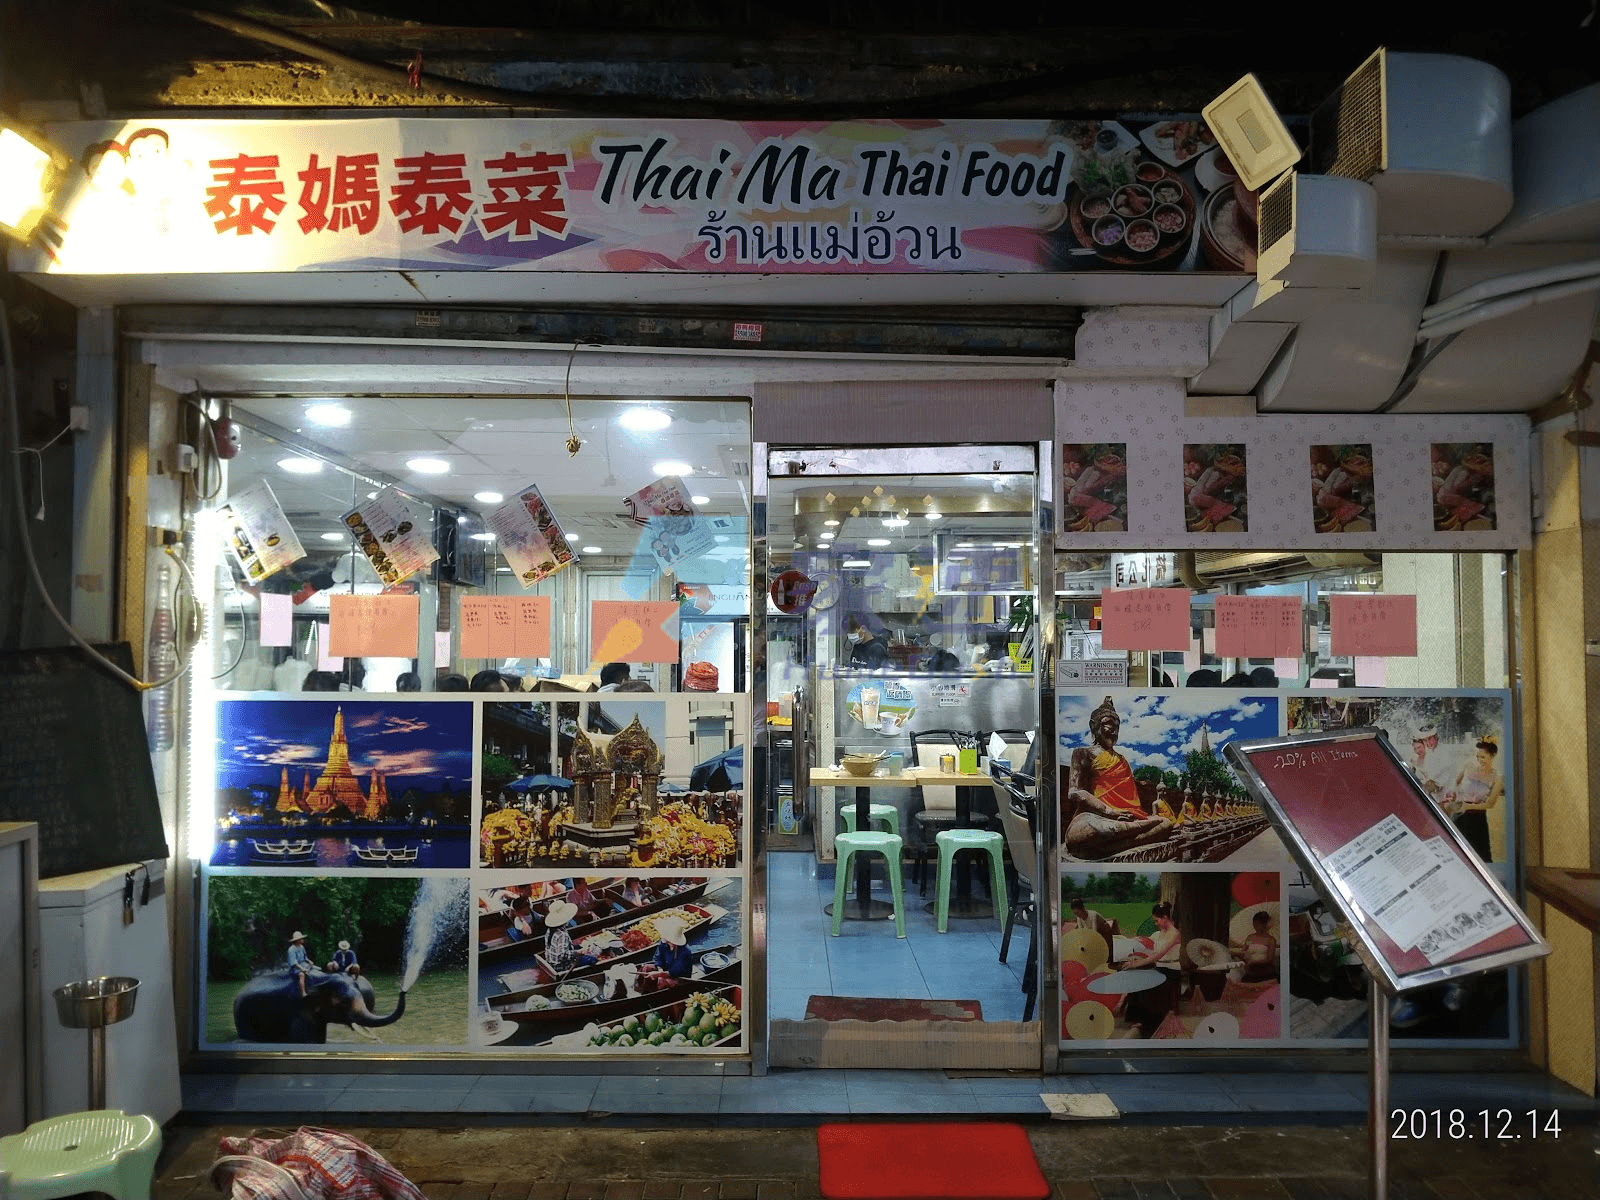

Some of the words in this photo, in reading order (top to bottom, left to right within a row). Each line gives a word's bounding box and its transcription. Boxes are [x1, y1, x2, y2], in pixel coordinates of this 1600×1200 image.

[205, 152, 570, 238] 泰媽泰菜
[599, 137, 732, 203] Thai
[739, 144, 842, 205] Ma
[860, 148, 949, 197] Thai
[960, 149, 1066, 198] Food
[699, 209, 962, 261] ร้านแม่อ้วน
[1273, 752, 1307, 769] -20%
[1310, 750, 1327, 765] All
[1328, 749, 1359, 761] Items
